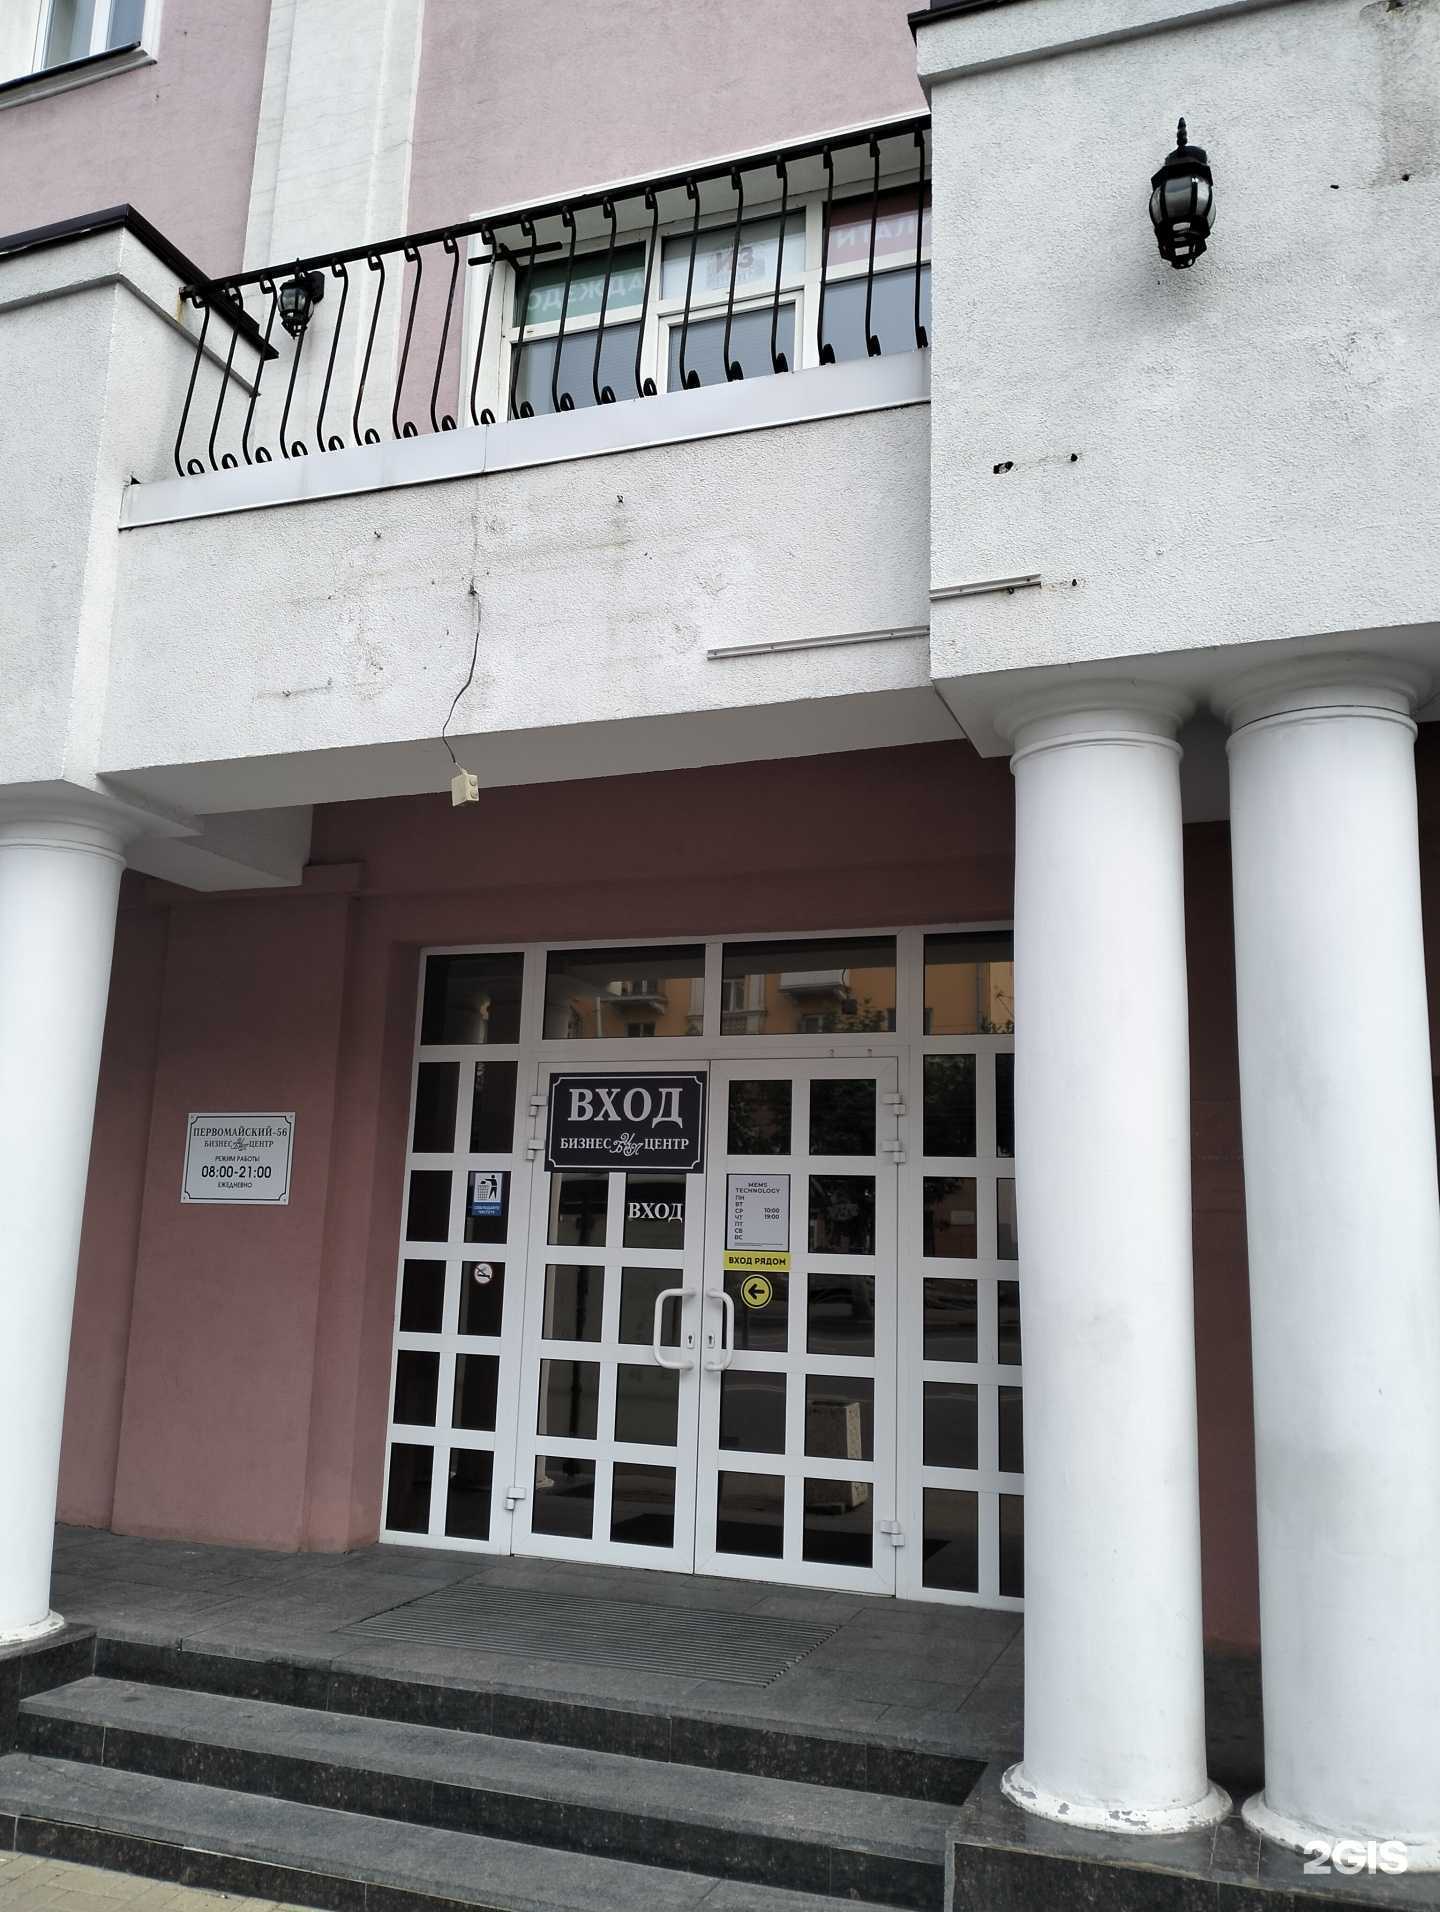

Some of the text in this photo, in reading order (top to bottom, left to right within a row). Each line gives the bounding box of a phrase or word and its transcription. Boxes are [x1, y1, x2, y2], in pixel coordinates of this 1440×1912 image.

[567, 1087, 683, 1129] ВХОД
[193, 1125, 288, 1137] ПЕРВОМАЙСКИЙ-56
[204, 1140, 232, 1148] БИЗНЕС
[249, 1140, 274, 1148] ЦЕНТР
[560, 1137, 612, 1150] БИЗНЕС
[644, 1137, 689, 1151] ЦЕНТР
[201, 1165, 272, 1179] 08:00-21:00
[217, 1181, 253, 1189] ЕЖЕДНЕВНО
[628, 1202, 684, 1224] ВХОД
[728, 1256, 786, 1266] ВХОД РЯДОМ
